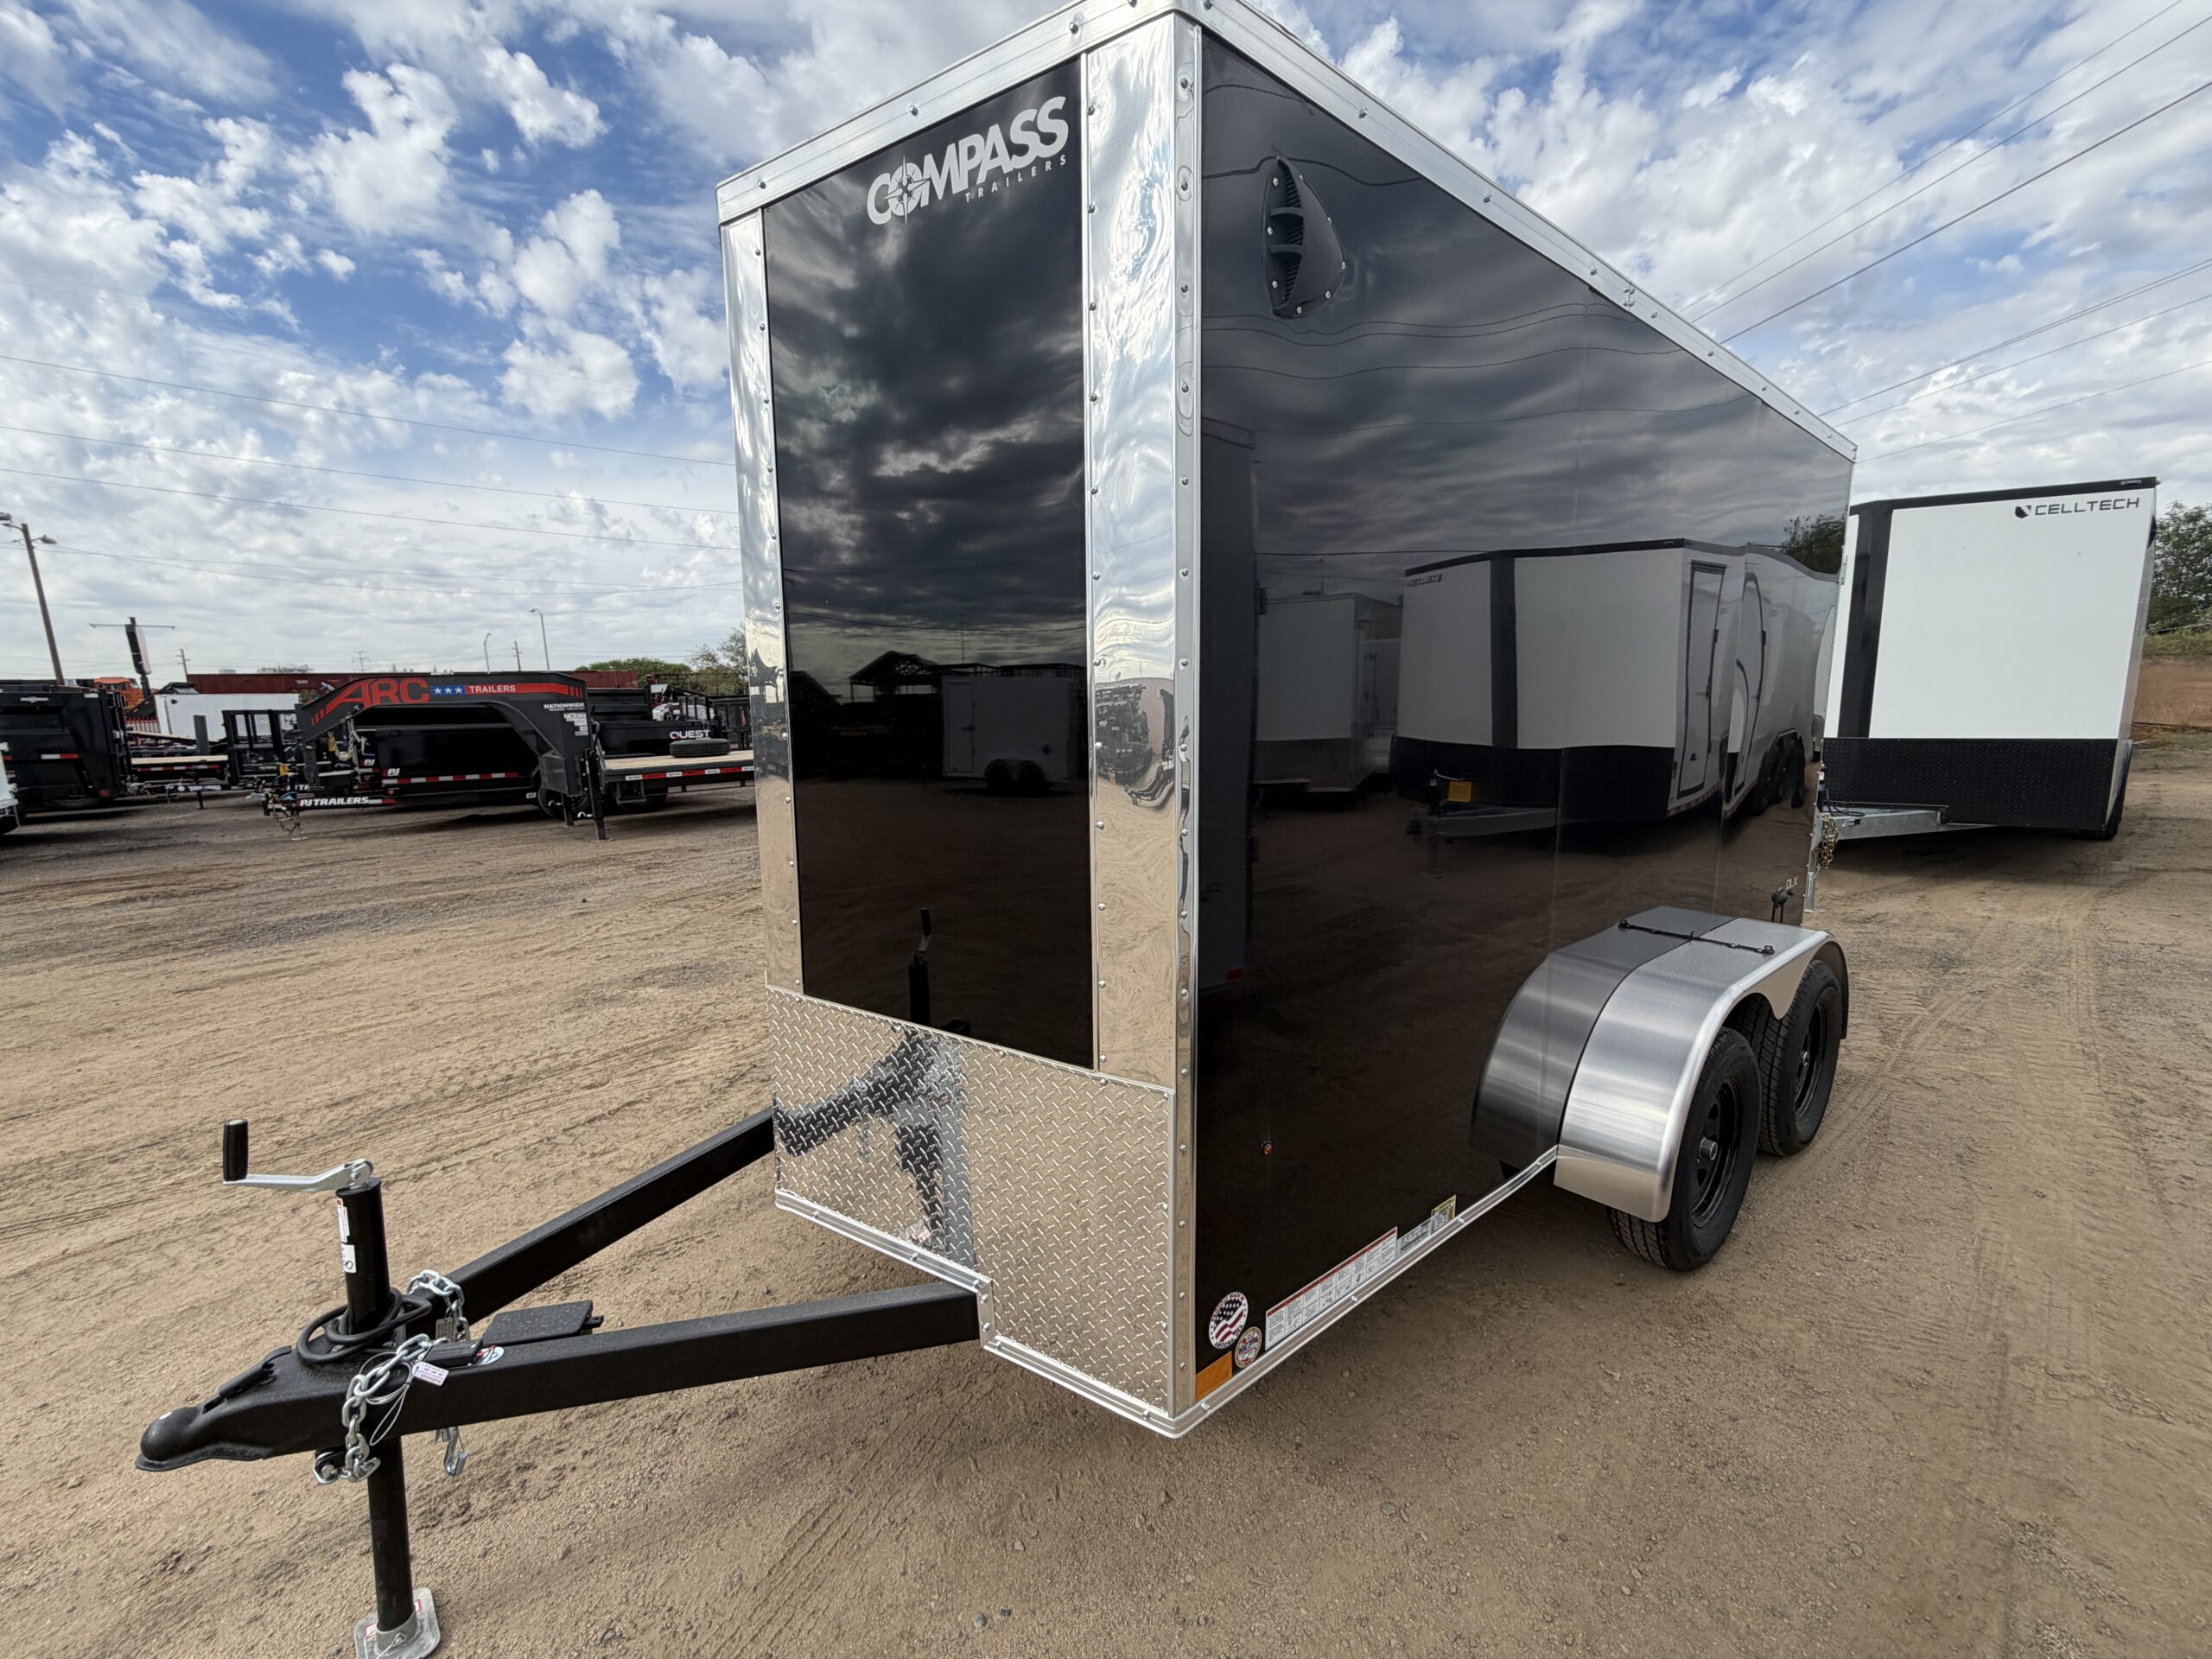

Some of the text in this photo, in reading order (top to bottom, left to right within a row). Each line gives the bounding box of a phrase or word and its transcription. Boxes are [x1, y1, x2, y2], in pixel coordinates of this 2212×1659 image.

[867, 96, 1069, 225] COMPASS
[964, 154, 1067, 203] TRAILERS
[2034, 497, 2140, 516] CELLTECH
[325, 677, 430, 713] ARC
[468, 683, 516, 694] TRAILERS
[669, 729, 710, 740] QUEST
[387, 768, 400, 777] PJ
[300, 796, 369, 807] PJ TRAILERS
[1785, 875, 1799, 891] DLX
